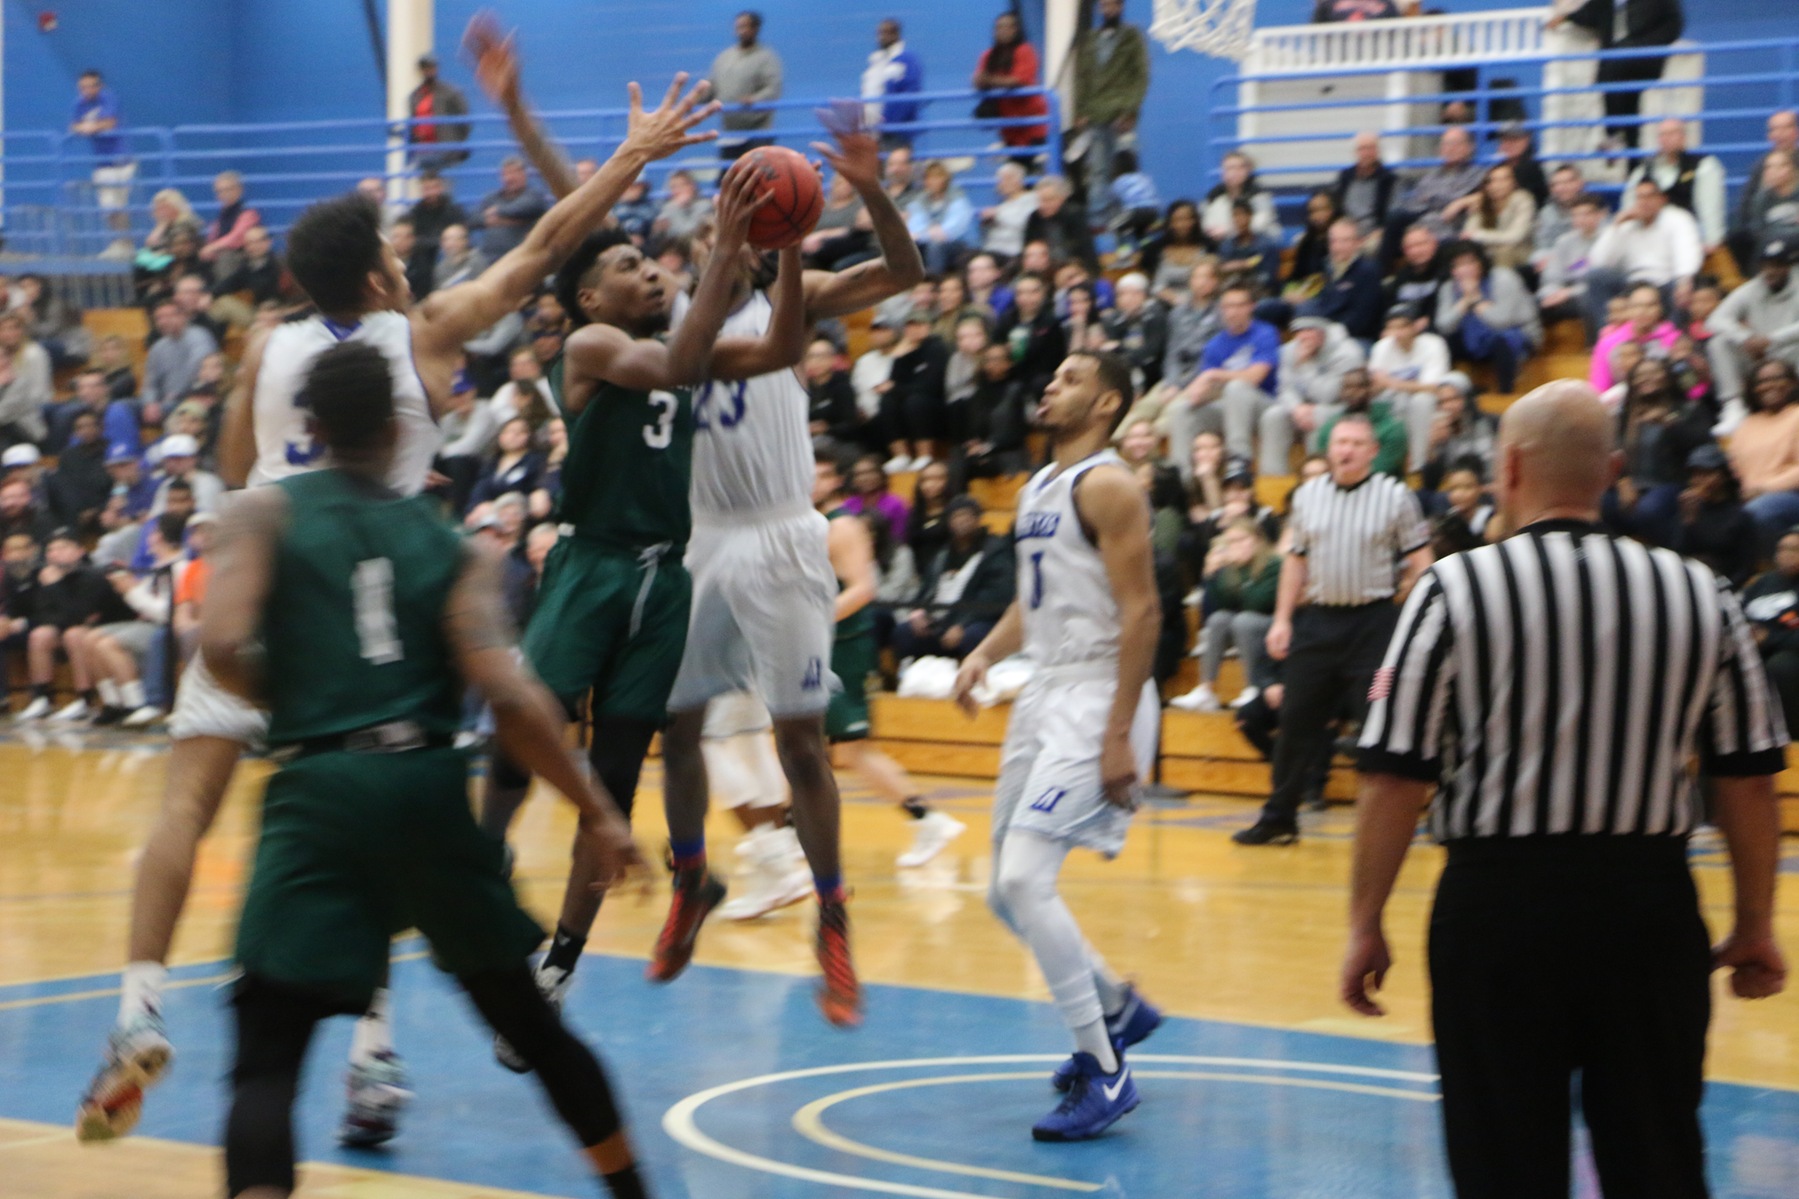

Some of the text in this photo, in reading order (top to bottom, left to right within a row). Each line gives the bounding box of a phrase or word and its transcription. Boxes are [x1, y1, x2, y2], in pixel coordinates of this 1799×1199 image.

[642, 388, 679, 449] 3
[1029, 551, 1045, 610] 1
[349, 557, 404, 666] 1
